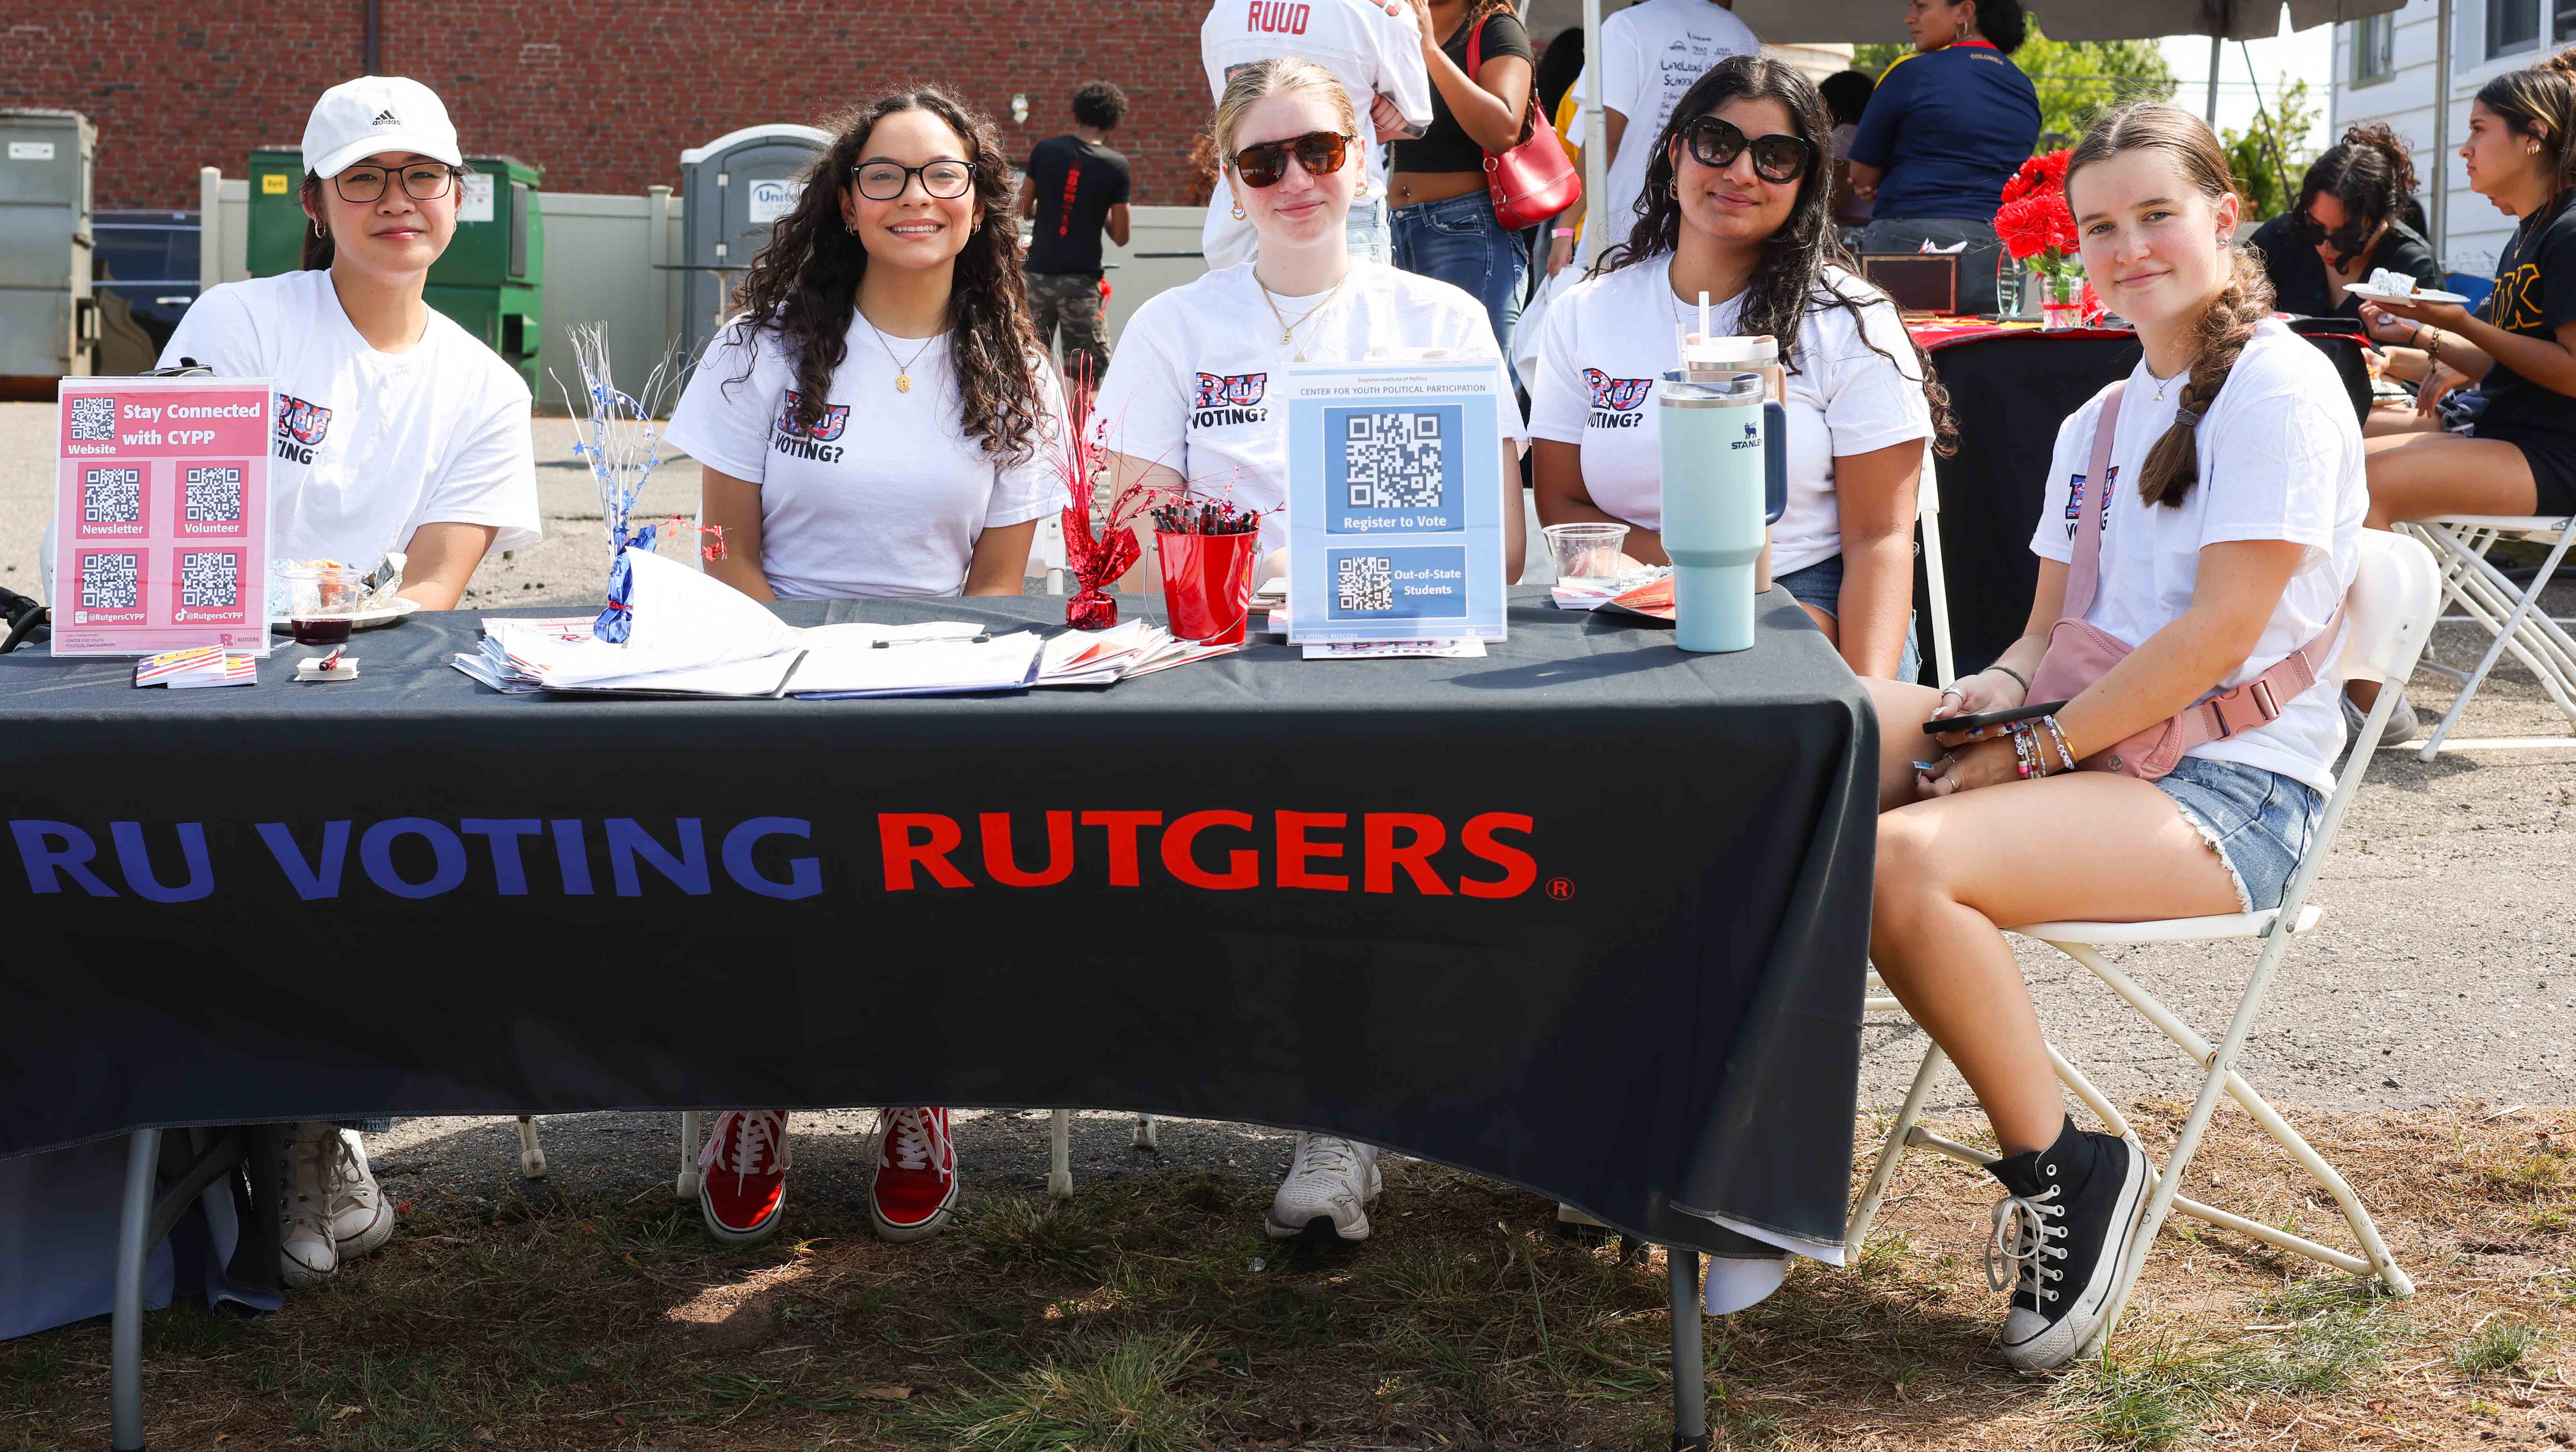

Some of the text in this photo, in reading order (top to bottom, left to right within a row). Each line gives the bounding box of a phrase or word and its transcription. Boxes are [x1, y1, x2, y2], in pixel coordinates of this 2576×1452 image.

[1247, 1, 1310, 35] RUUD
[1196, 372, 1267, 409] RU
[1383, 385, 1423, 393] POLITICAL
[1426, 384, 1486, 392] PARTICIPATION
[1582, 368, 1653, 411] RU
[123, 402, 261, 422] Stay Connected
[1192, 408, 1268, 430] VOTING?
[1587, 411, 1644, 429] VOTING?
[122, 430, 215, 445] with CYPP
[67, 444, 116, 455] Website
[775, 432, 844, 464] VOTING?
[82, 524, 144, 534] Newsletter
[185, 523, 240, 533] Volunteer
[1344, 515, 1447, 531] Register to Vote
[1394, 569, 1461, 580] Out-of-State
[1404, 584, 1452, 595] Students
[89, 613, 145, 622] @RutgersCYPP
[186, 612, 243, 621] @RutgersCYPP
[7, 819, 215, 903] RU
[253, 816, 824, 901] VOTING
[877, 809, 1538, 899] RUTGERS
